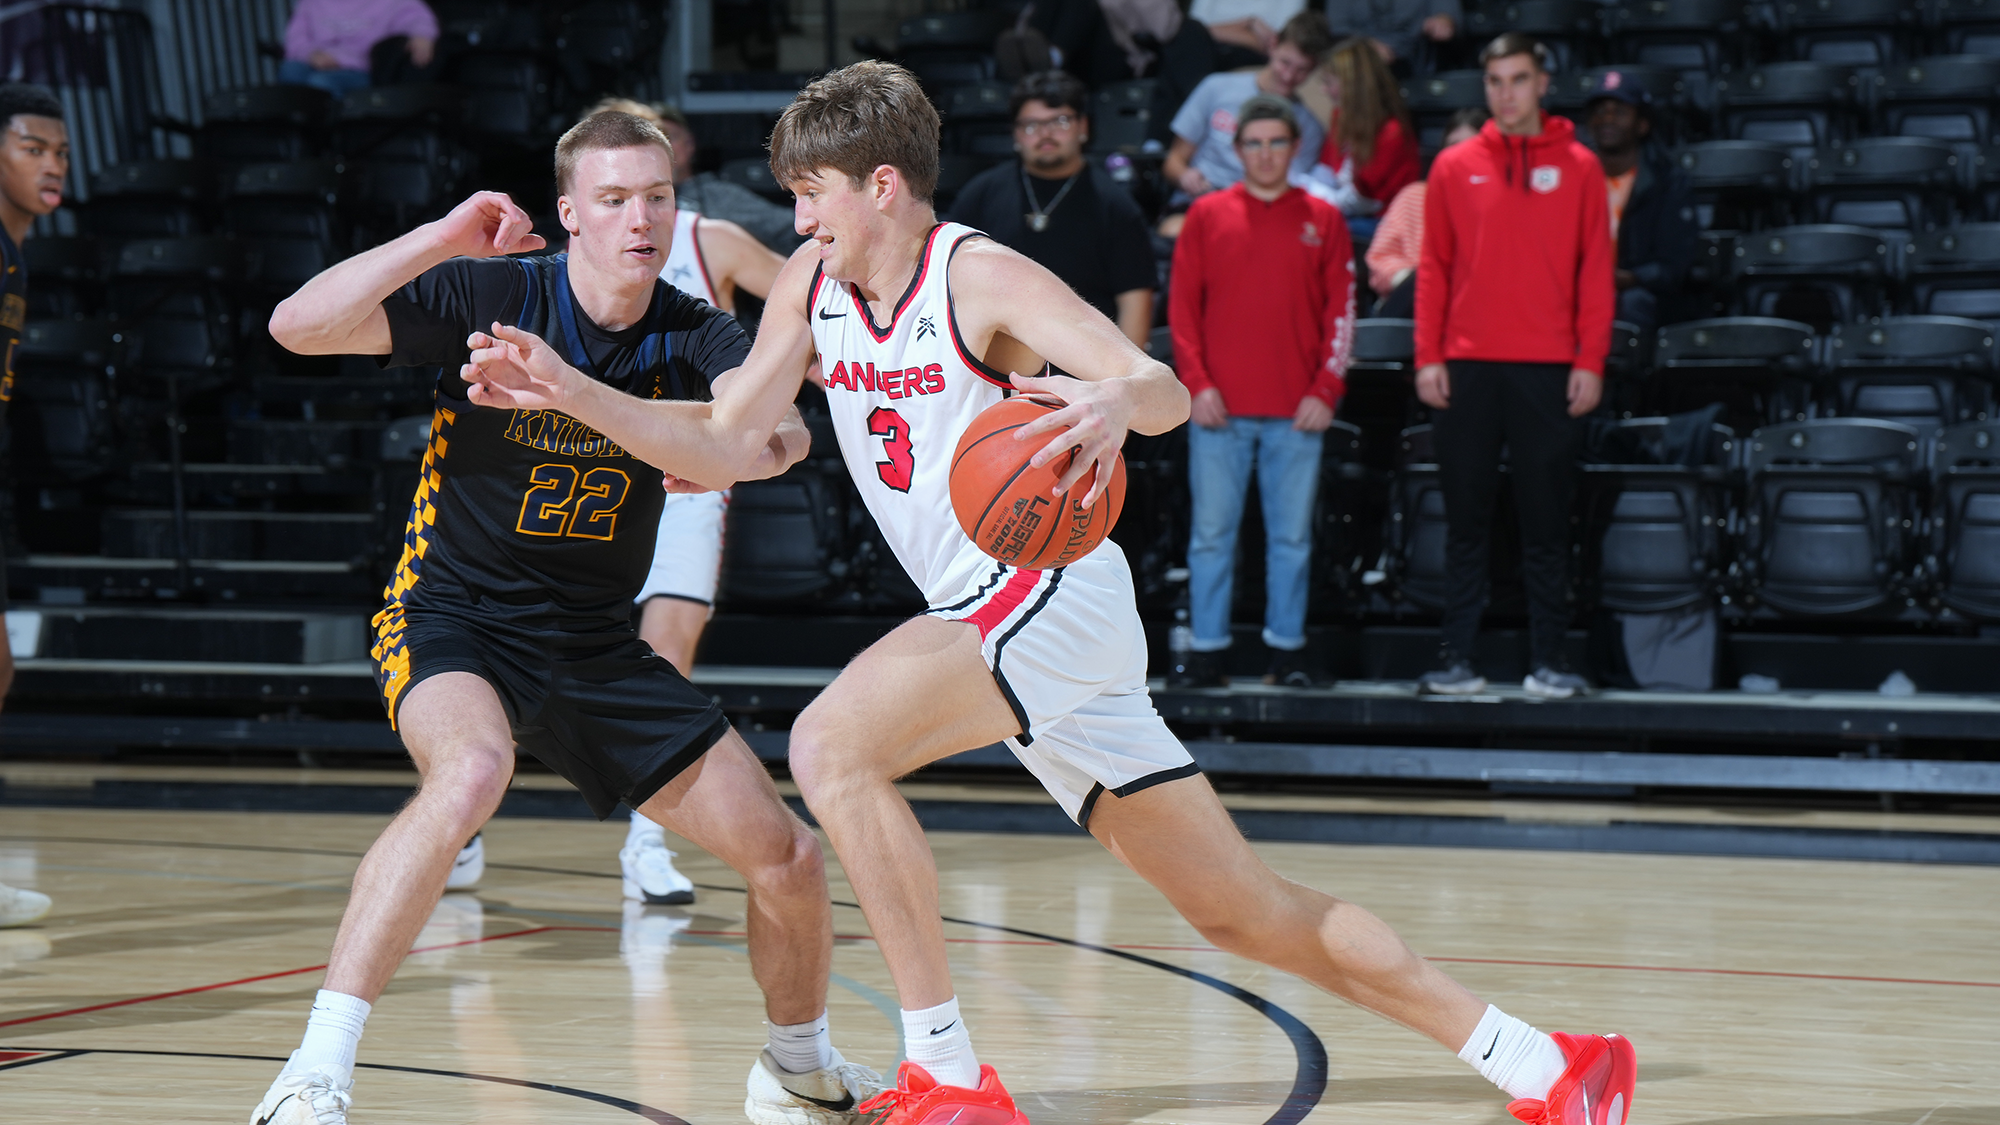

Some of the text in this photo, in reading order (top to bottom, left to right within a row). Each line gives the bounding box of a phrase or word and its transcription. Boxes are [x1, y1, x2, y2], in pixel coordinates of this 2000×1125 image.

[503, 407, 640, 460] KNIG
[866, 406, 915, 494] 3
[515, 463, 632, 542] 22
[998, 494, 1051, 565] LEGACY
